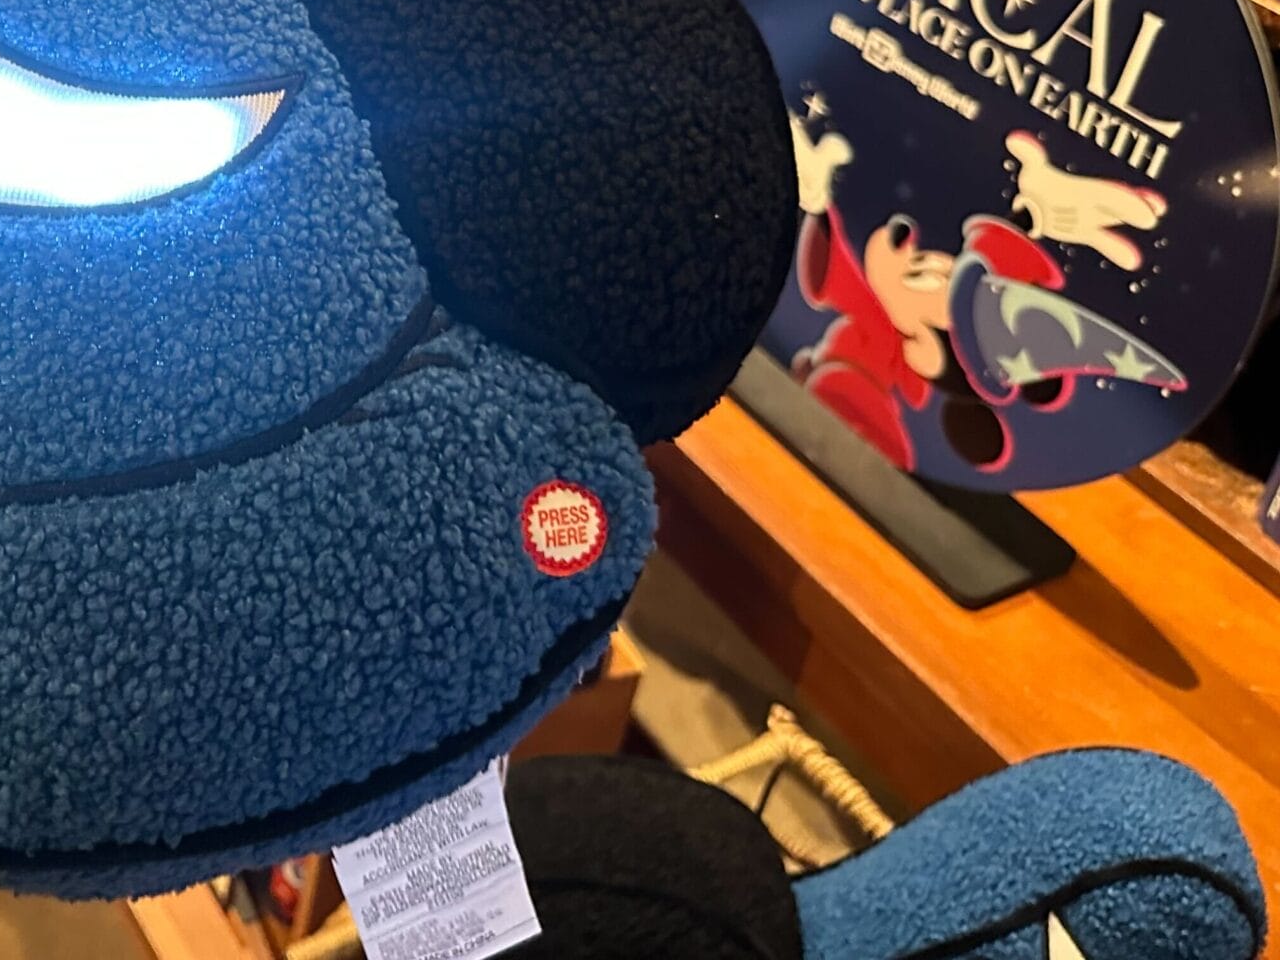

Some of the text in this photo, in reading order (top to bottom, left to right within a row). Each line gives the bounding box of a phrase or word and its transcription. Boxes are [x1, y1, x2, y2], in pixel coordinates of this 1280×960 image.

[968, 38, 1036, 97] ON
[1029, 72, 1170, 181] EARTH
[537, 504, 590, 528] PRESS
[545, 525, 589, 548] HERE
